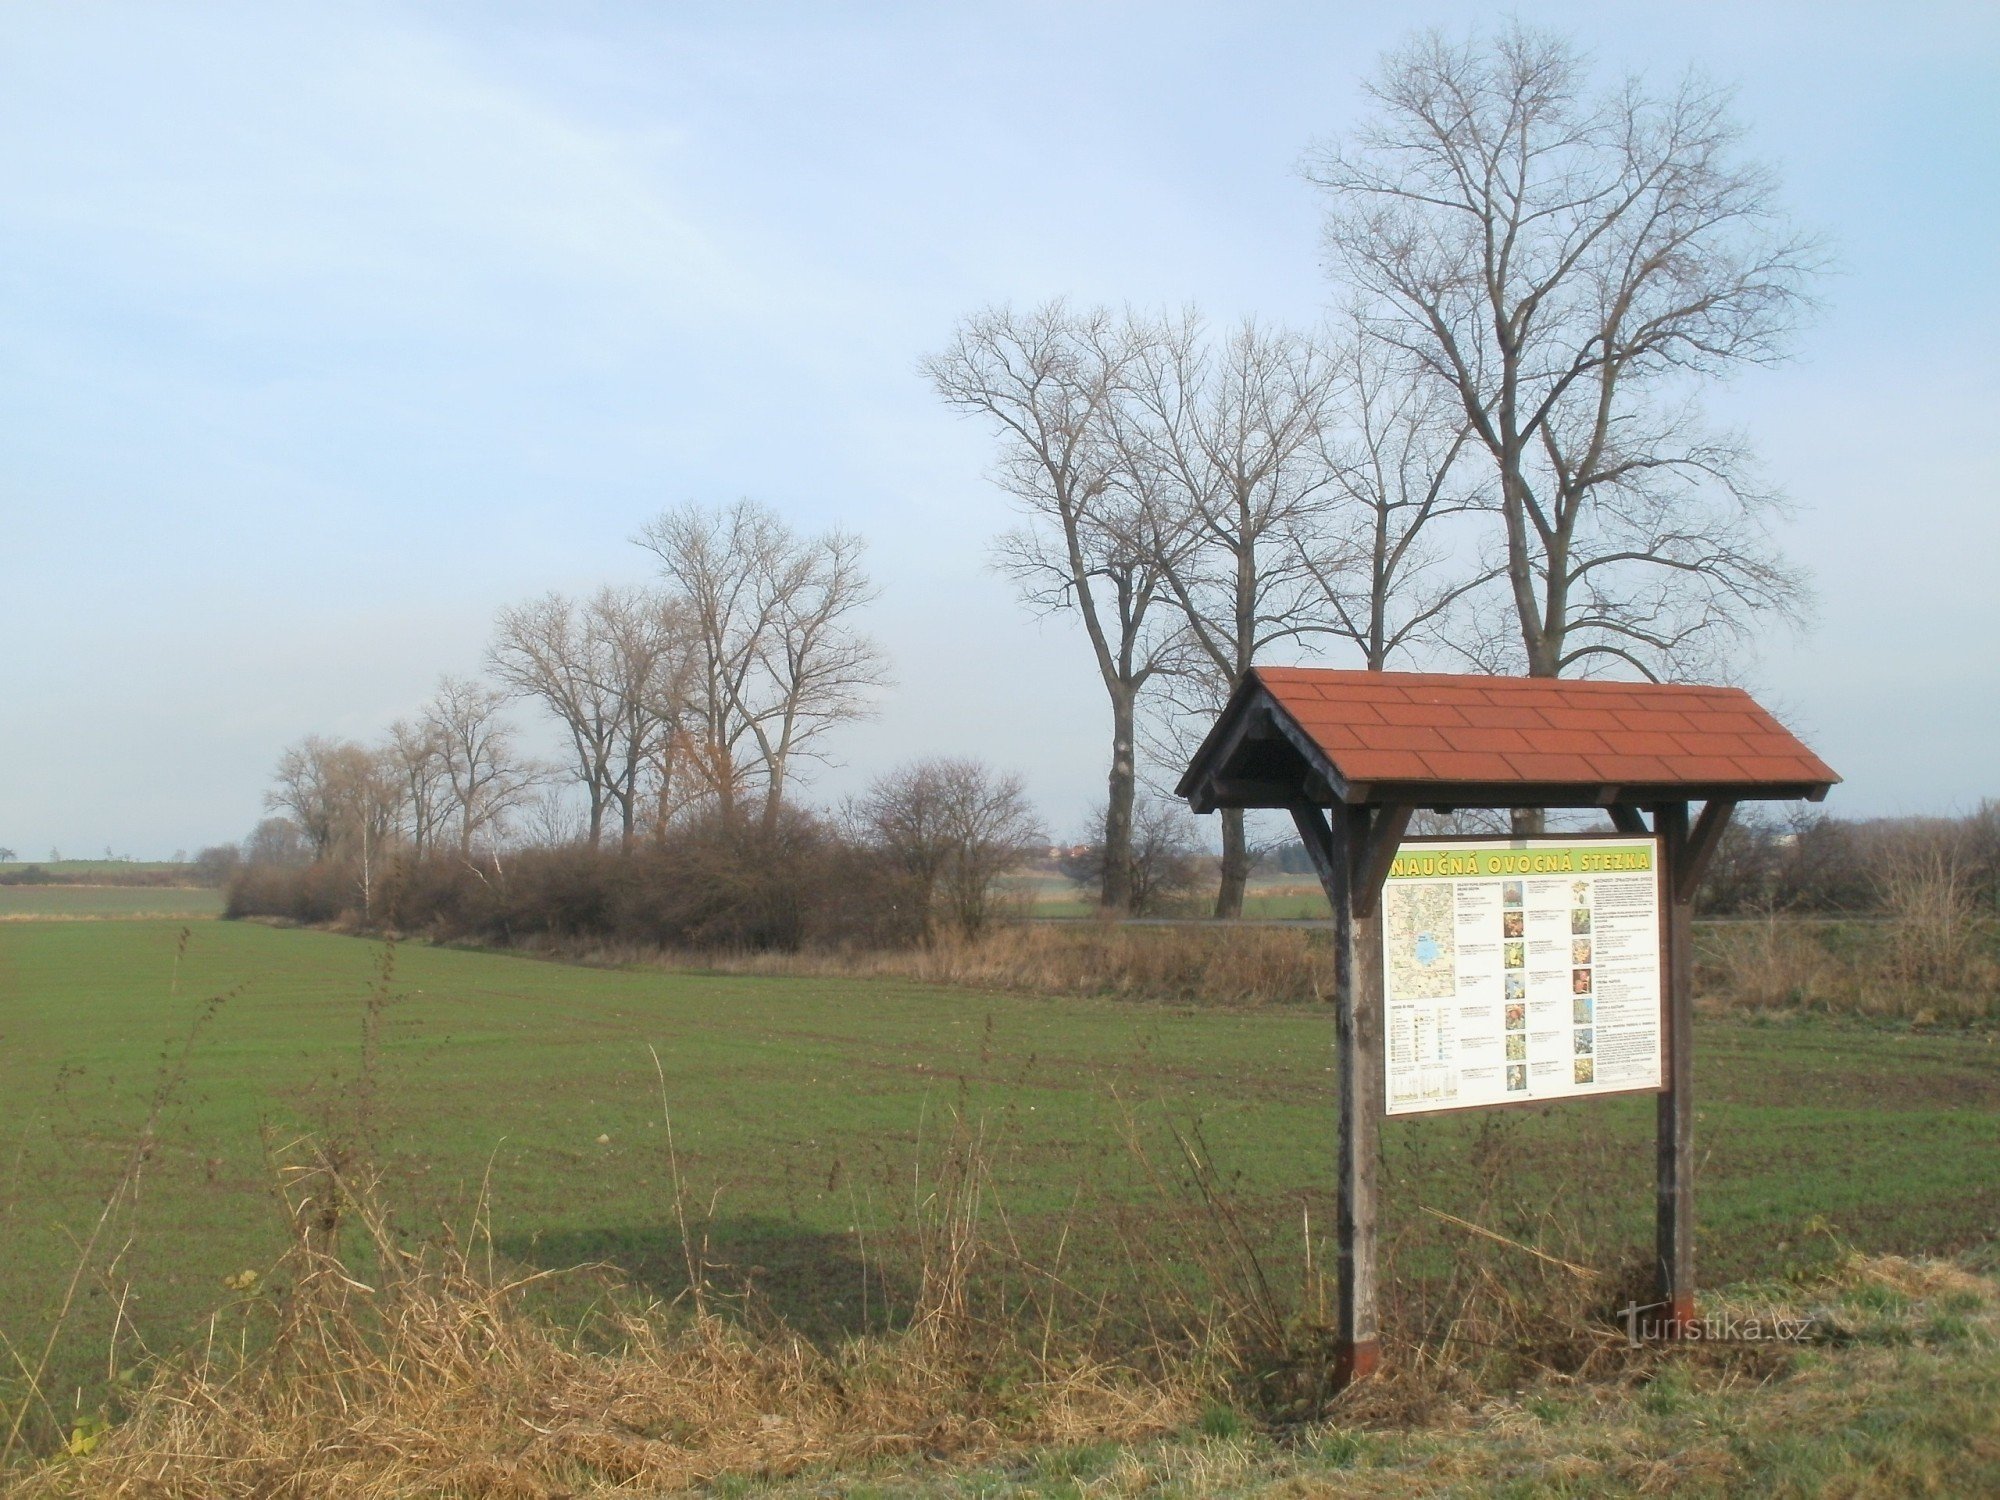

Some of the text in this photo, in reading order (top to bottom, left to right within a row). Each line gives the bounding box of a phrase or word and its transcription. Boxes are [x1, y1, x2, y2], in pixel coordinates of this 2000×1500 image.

[1391, 849, 1650, 876] NAUČNÁ OVOCNÁ STEZKA
